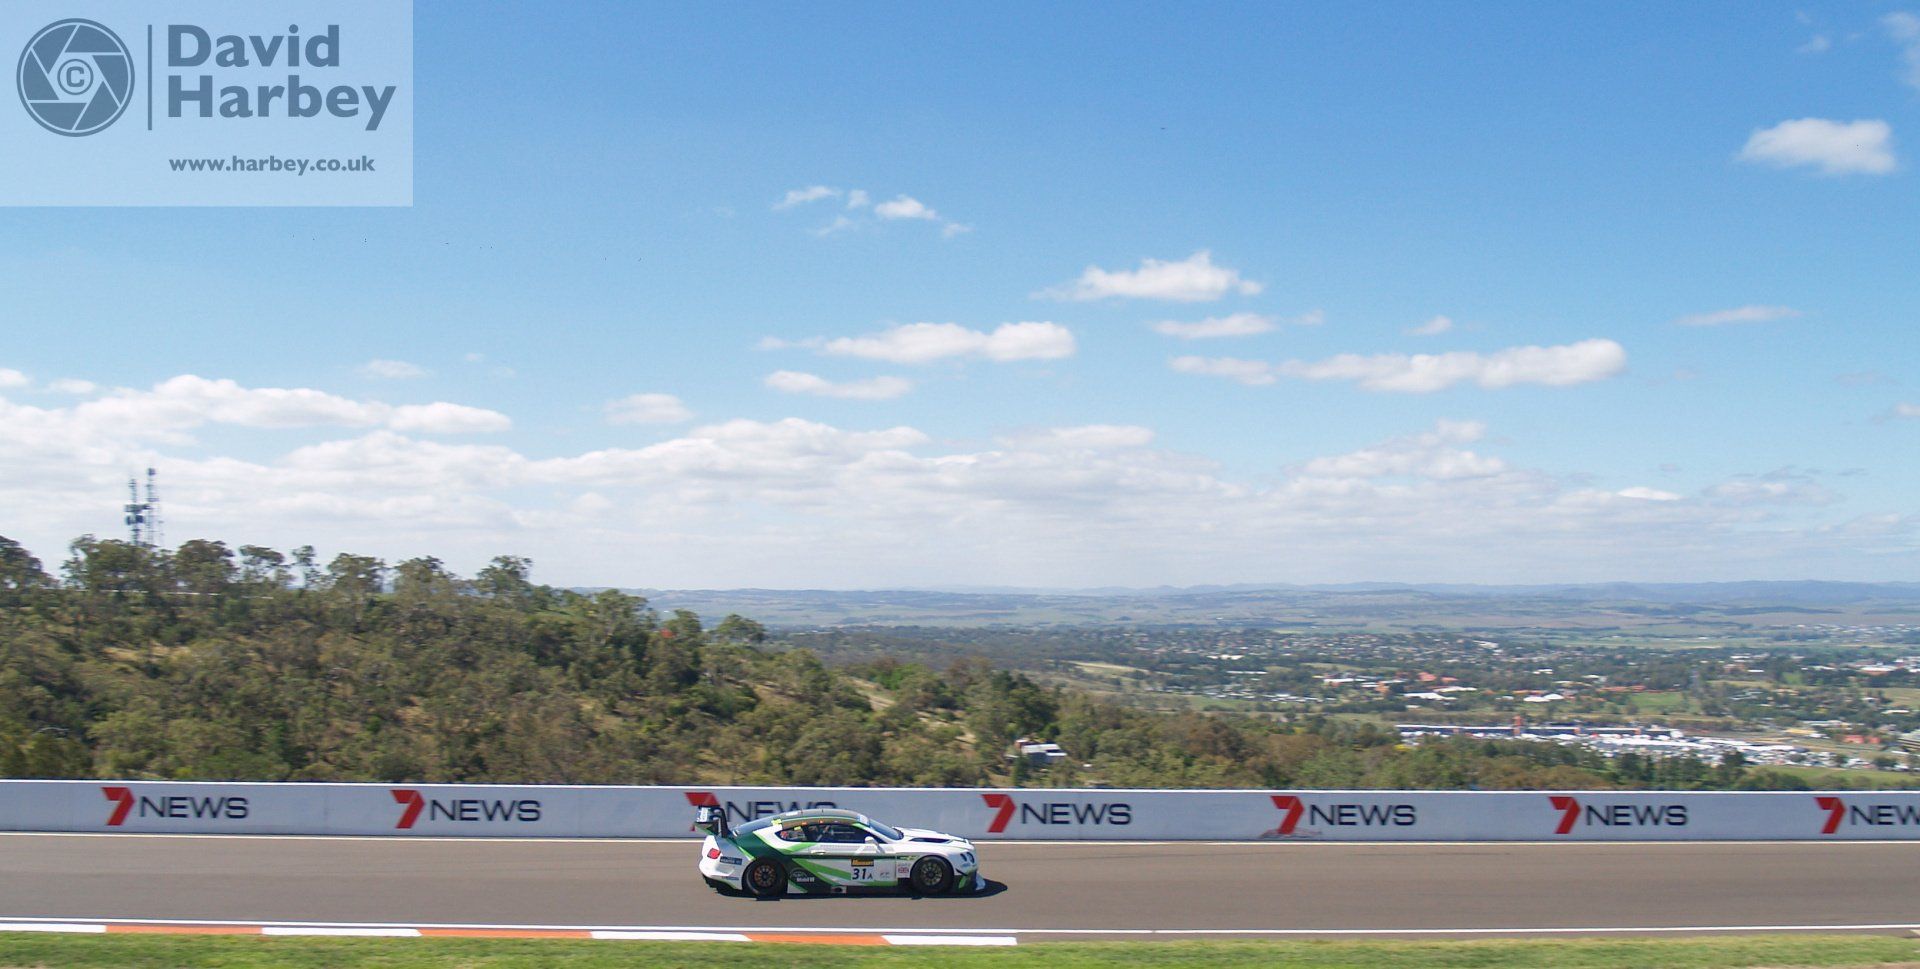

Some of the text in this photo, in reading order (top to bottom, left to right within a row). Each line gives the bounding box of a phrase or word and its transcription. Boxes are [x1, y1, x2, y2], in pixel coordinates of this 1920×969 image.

[139, 796, 248, 819] NEWS
[430, 800, 541, 822] NEWS
[1021, 803, 1132, 825] NEWS
[1309, 805, 1417, 826] NEWS
[1585, 805, 1689, 826] NEWS
